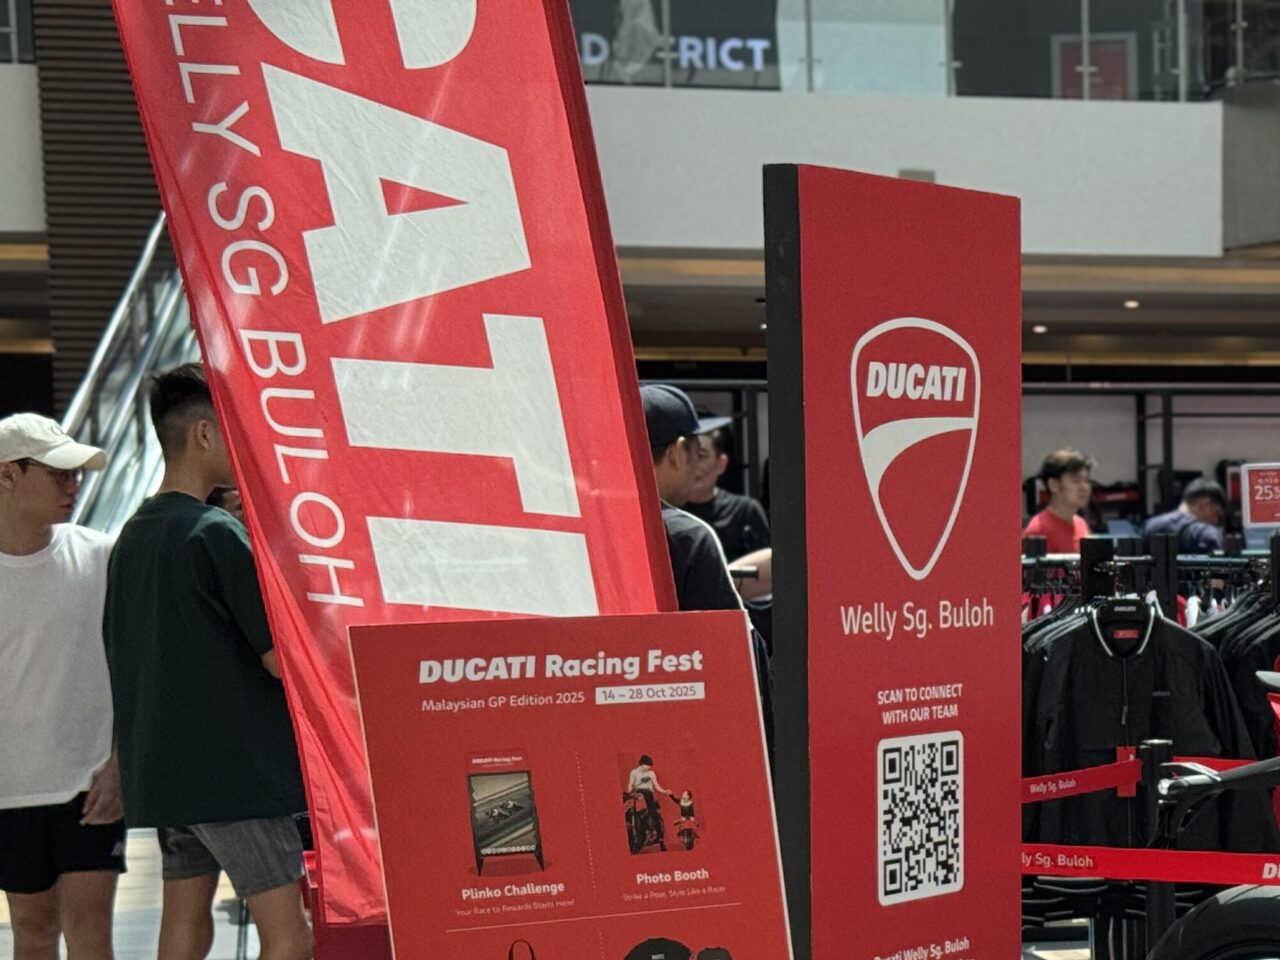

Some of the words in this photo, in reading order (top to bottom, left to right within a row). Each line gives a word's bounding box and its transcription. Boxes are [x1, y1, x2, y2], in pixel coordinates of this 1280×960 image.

[165, 0, 262, 157] LLY
[207, 180, 290, 297] SG
[866, 361, 967, 402] DUCATI
[238, 328, 365, 608] BULOH
[840, 602, 897, 641] Welly
[903, 602, 933, 638] Sg.
[939, 597, 994, 628] Buloh
[419, 656, 536, 683] DUCATI
[545, 652, 640, 680] Racing
[648, 650, 703, 673] Fest
[422, 697, 485, 713] Malaysian
[488, 696, 507, 708] GP
[510, 694, 553, 707] Edition
[555, 691, 585, 704] 2025
[602, 690, 615, 701] 14
[629, 687, 644, 699] 28
[646, 687, 666, 699] Oct
[669, 685, 697, 698] 2025
[877, 688, 903, 705] SCAN
[905, 687, 918, 701] TO
[919, 683, 963, 700] CONNECT
[882, 709, 908, 724] WITH
[910, 706, 930, 721] OUR
[931, 704, 958, 720] TEAM
[1029, 783, 1047, 794] Welly
[1048, 781, 1057, 793] Sg.
[1058, 778, 1077, 790] Buloh
[1035, 852, 1054, 869] Sg.
[1057, 854, 1093, 868] Buloh
[636, 873, 672, 884] Photo
[674, 868, 709, 881] Booth
[461, 887, 502, 900] Plinko
[504, 883, 565, 896] Challenge
[455, 909, 472, 917] Your
[473, 907, 491, 915] Race
[532, 901, 555, 910] Starts
[930, 944, 944, 959] Sg.
[944, 936, 970, 954] Buloh
